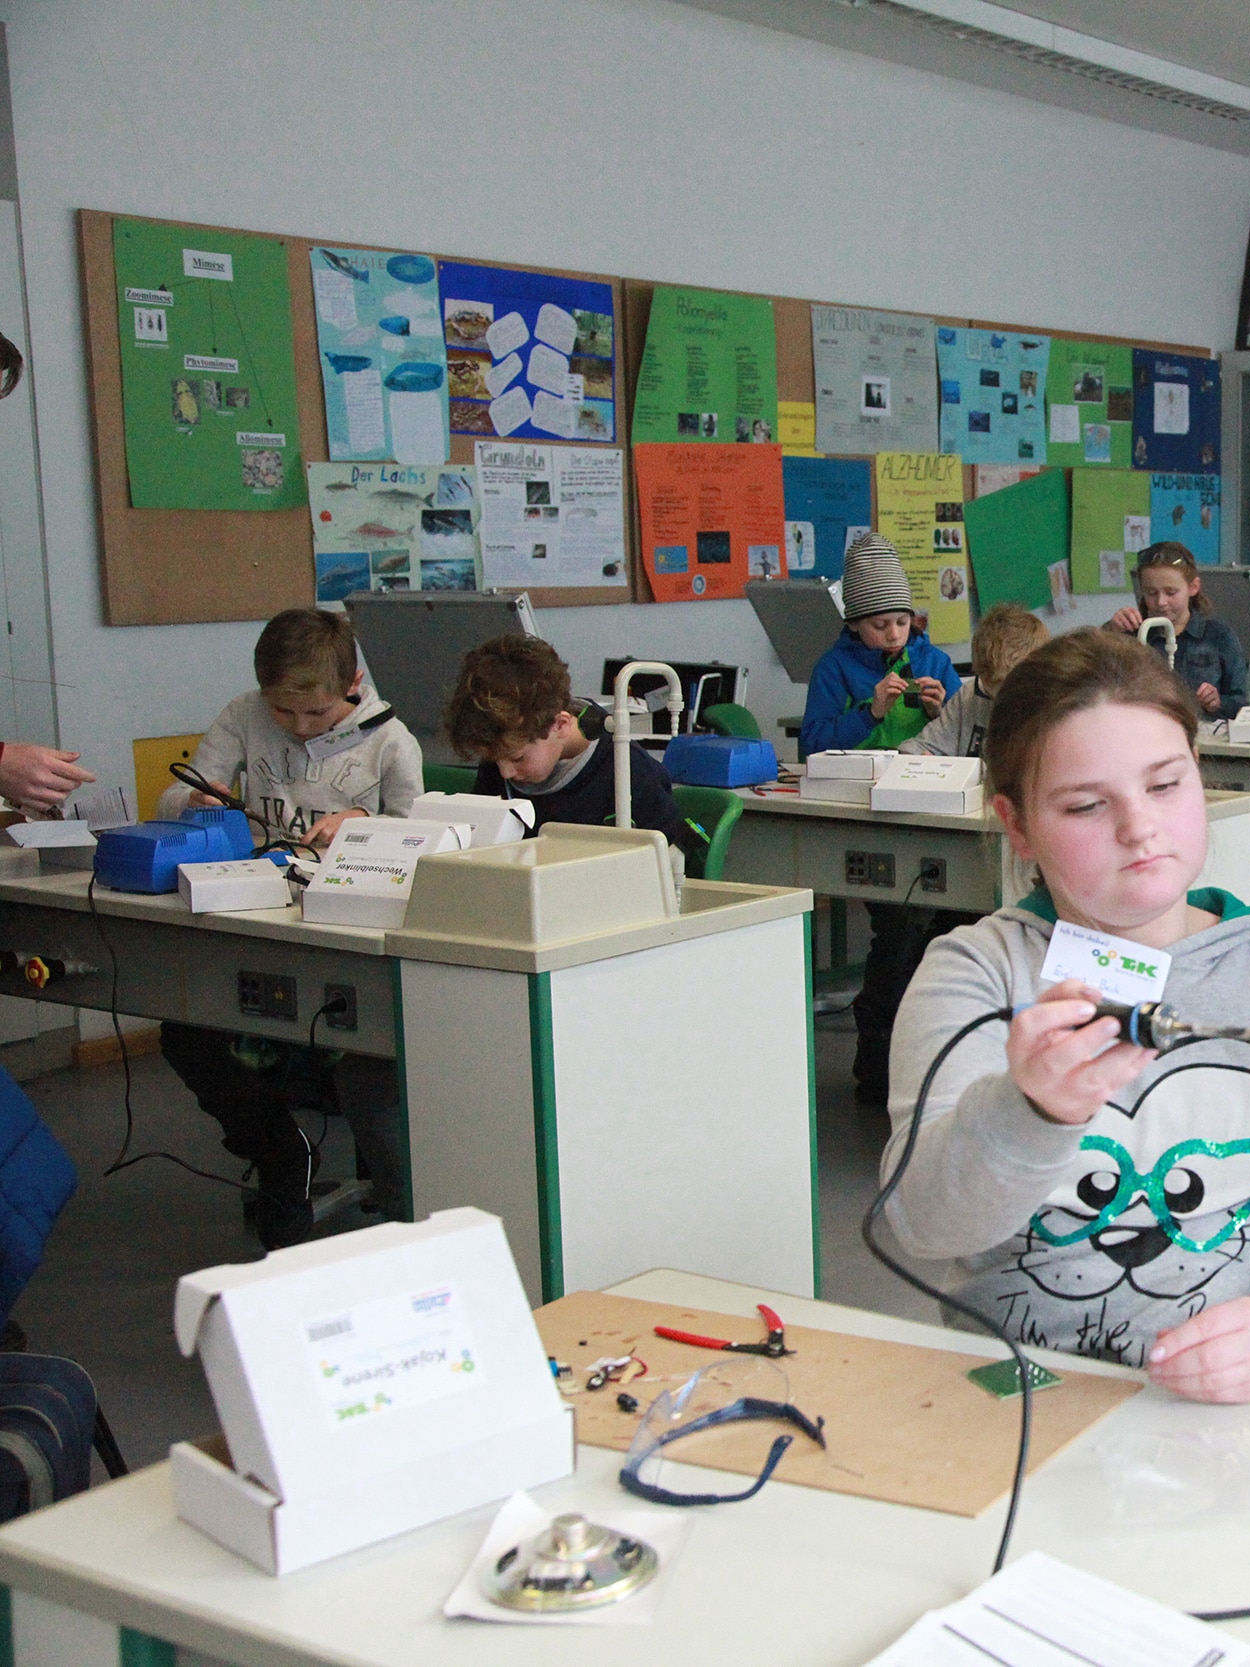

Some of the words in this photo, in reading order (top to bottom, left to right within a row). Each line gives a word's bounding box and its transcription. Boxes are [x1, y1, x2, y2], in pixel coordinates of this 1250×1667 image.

[192, 257, 225, 270] Mimese
[126, 289, 172, 302] Zoomimese
[186, 357, 236, 370] Phytomimese
[352, 466, 374, 483] Der
[381, 466, 426, 484] Lachs
[336, 863, 403, 876] Wechselblinker
